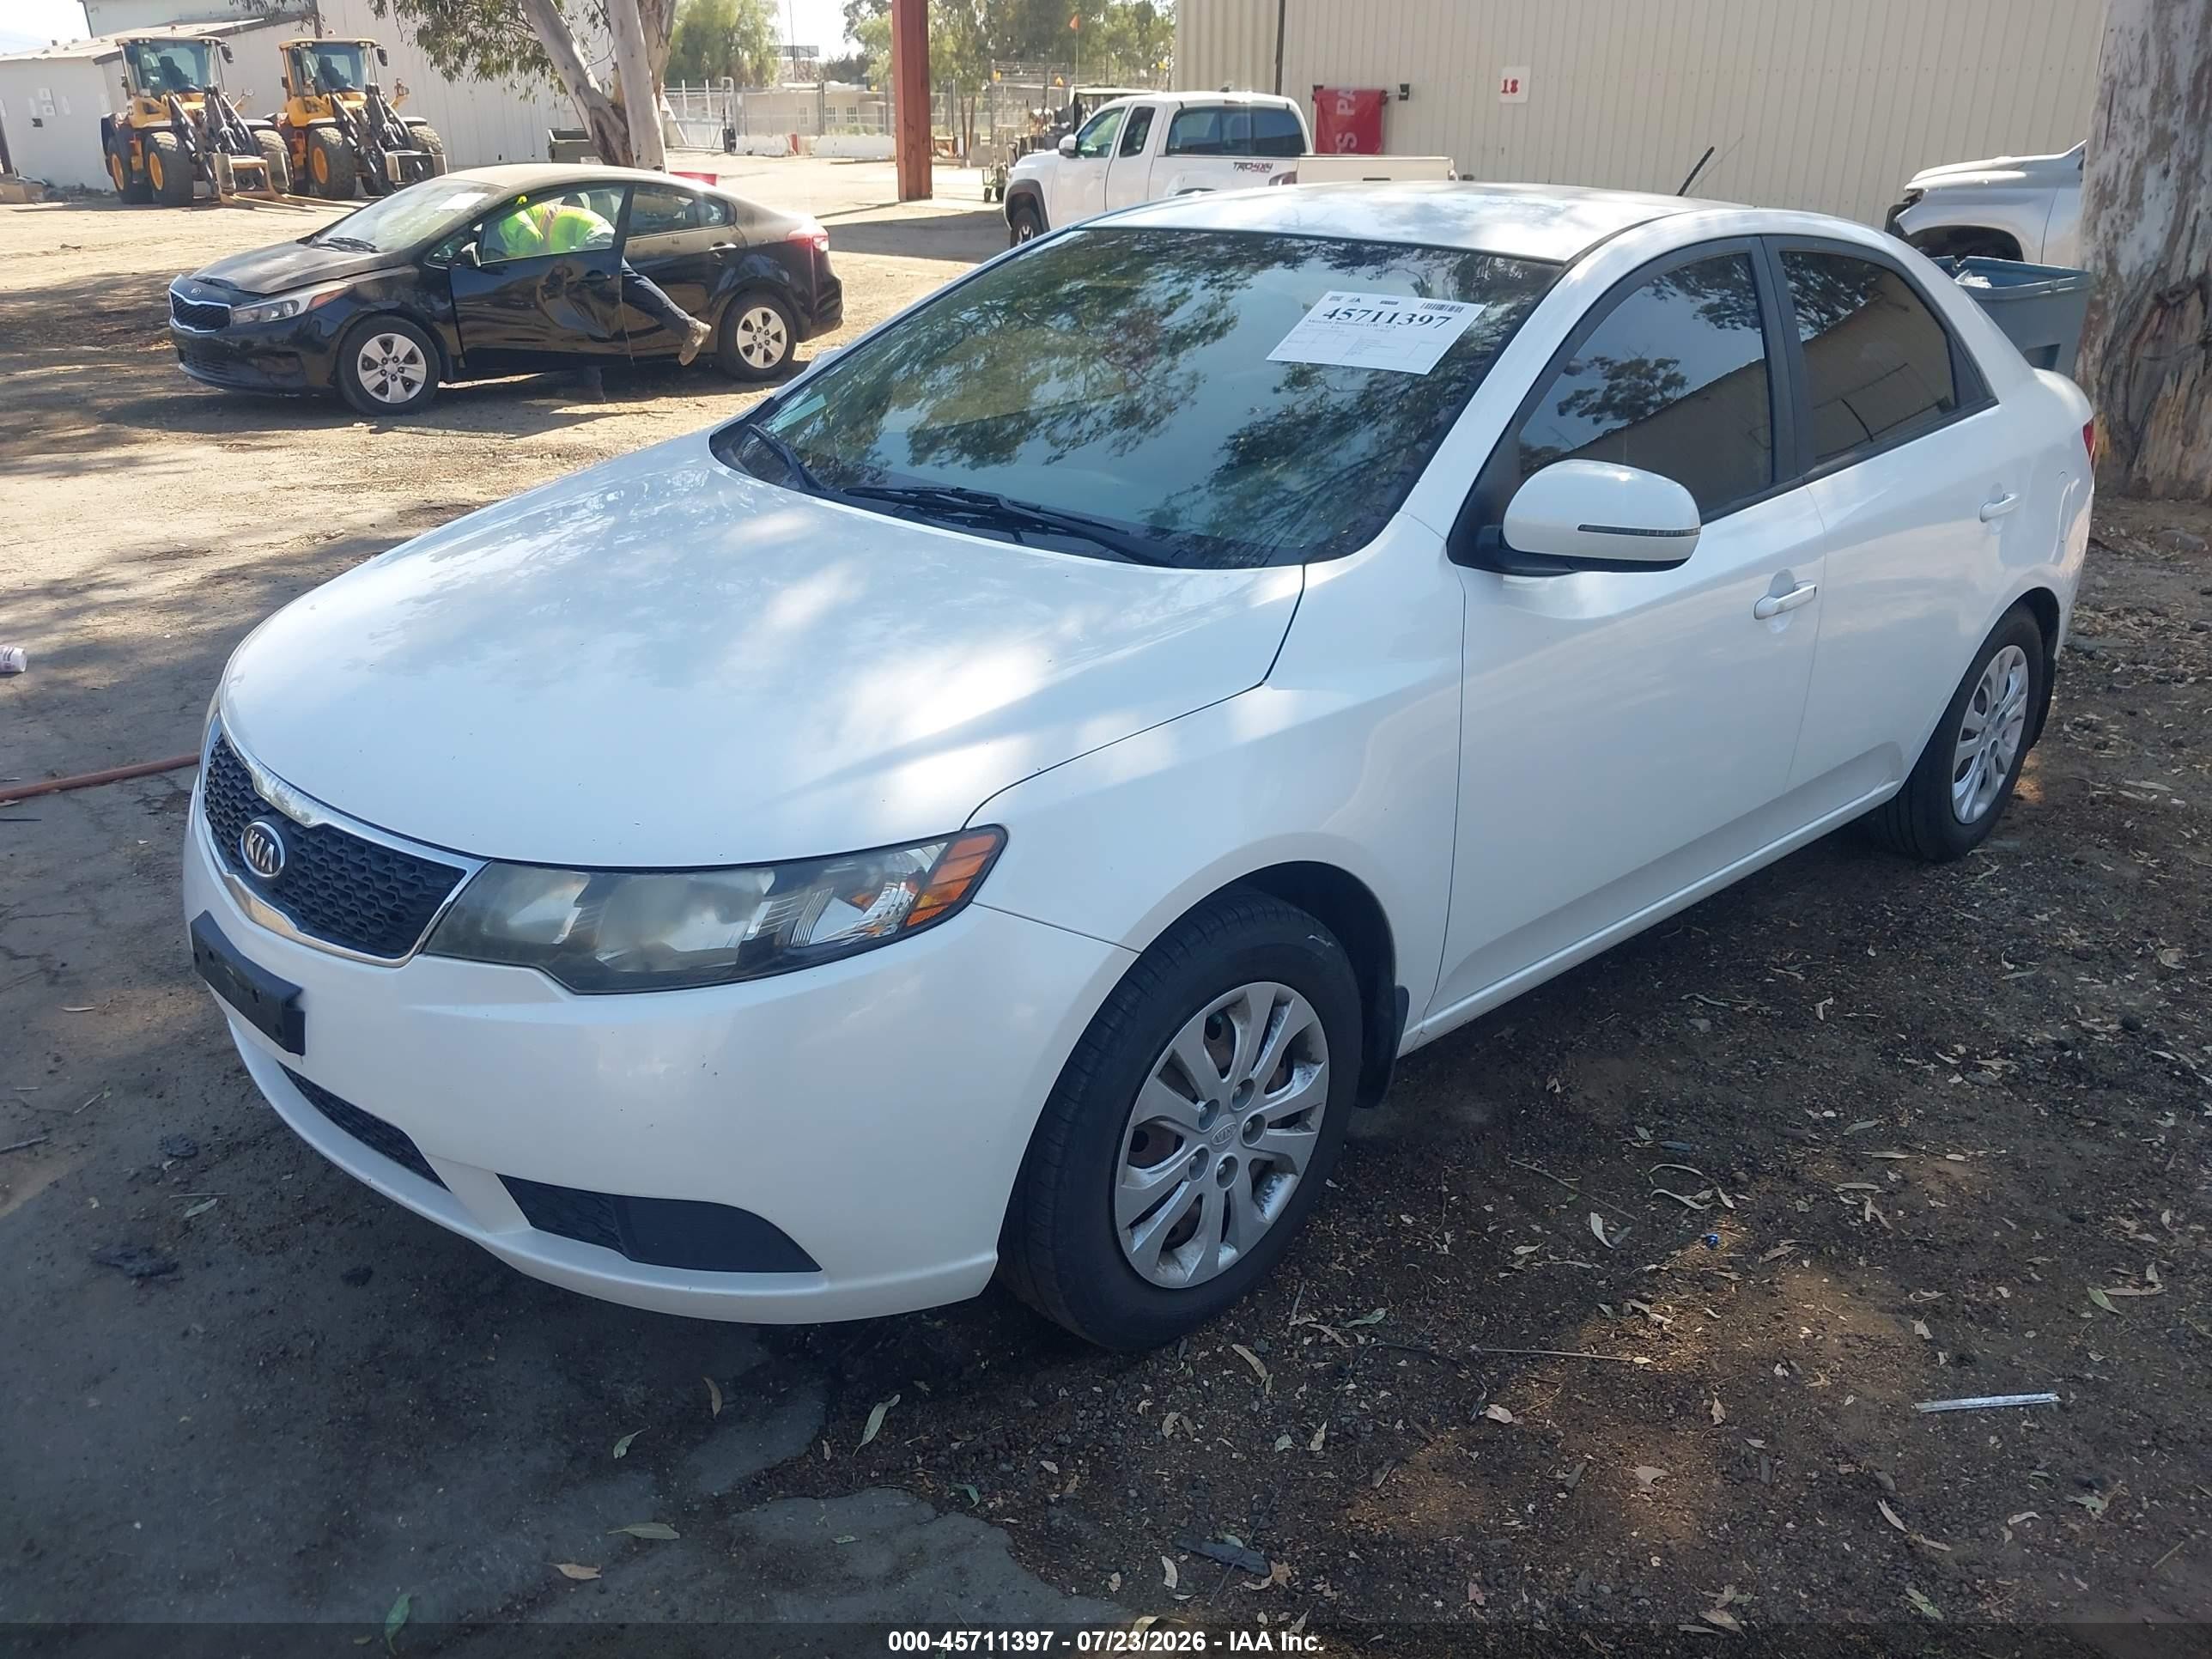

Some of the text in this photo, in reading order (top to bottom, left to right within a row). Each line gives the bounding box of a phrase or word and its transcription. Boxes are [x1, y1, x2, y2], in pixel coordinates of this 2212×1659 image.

[1501, 79, 1519, 94] 18
[1322, 307, 1453, 330] 45711397
[246, 829, 275, 872] KIA
